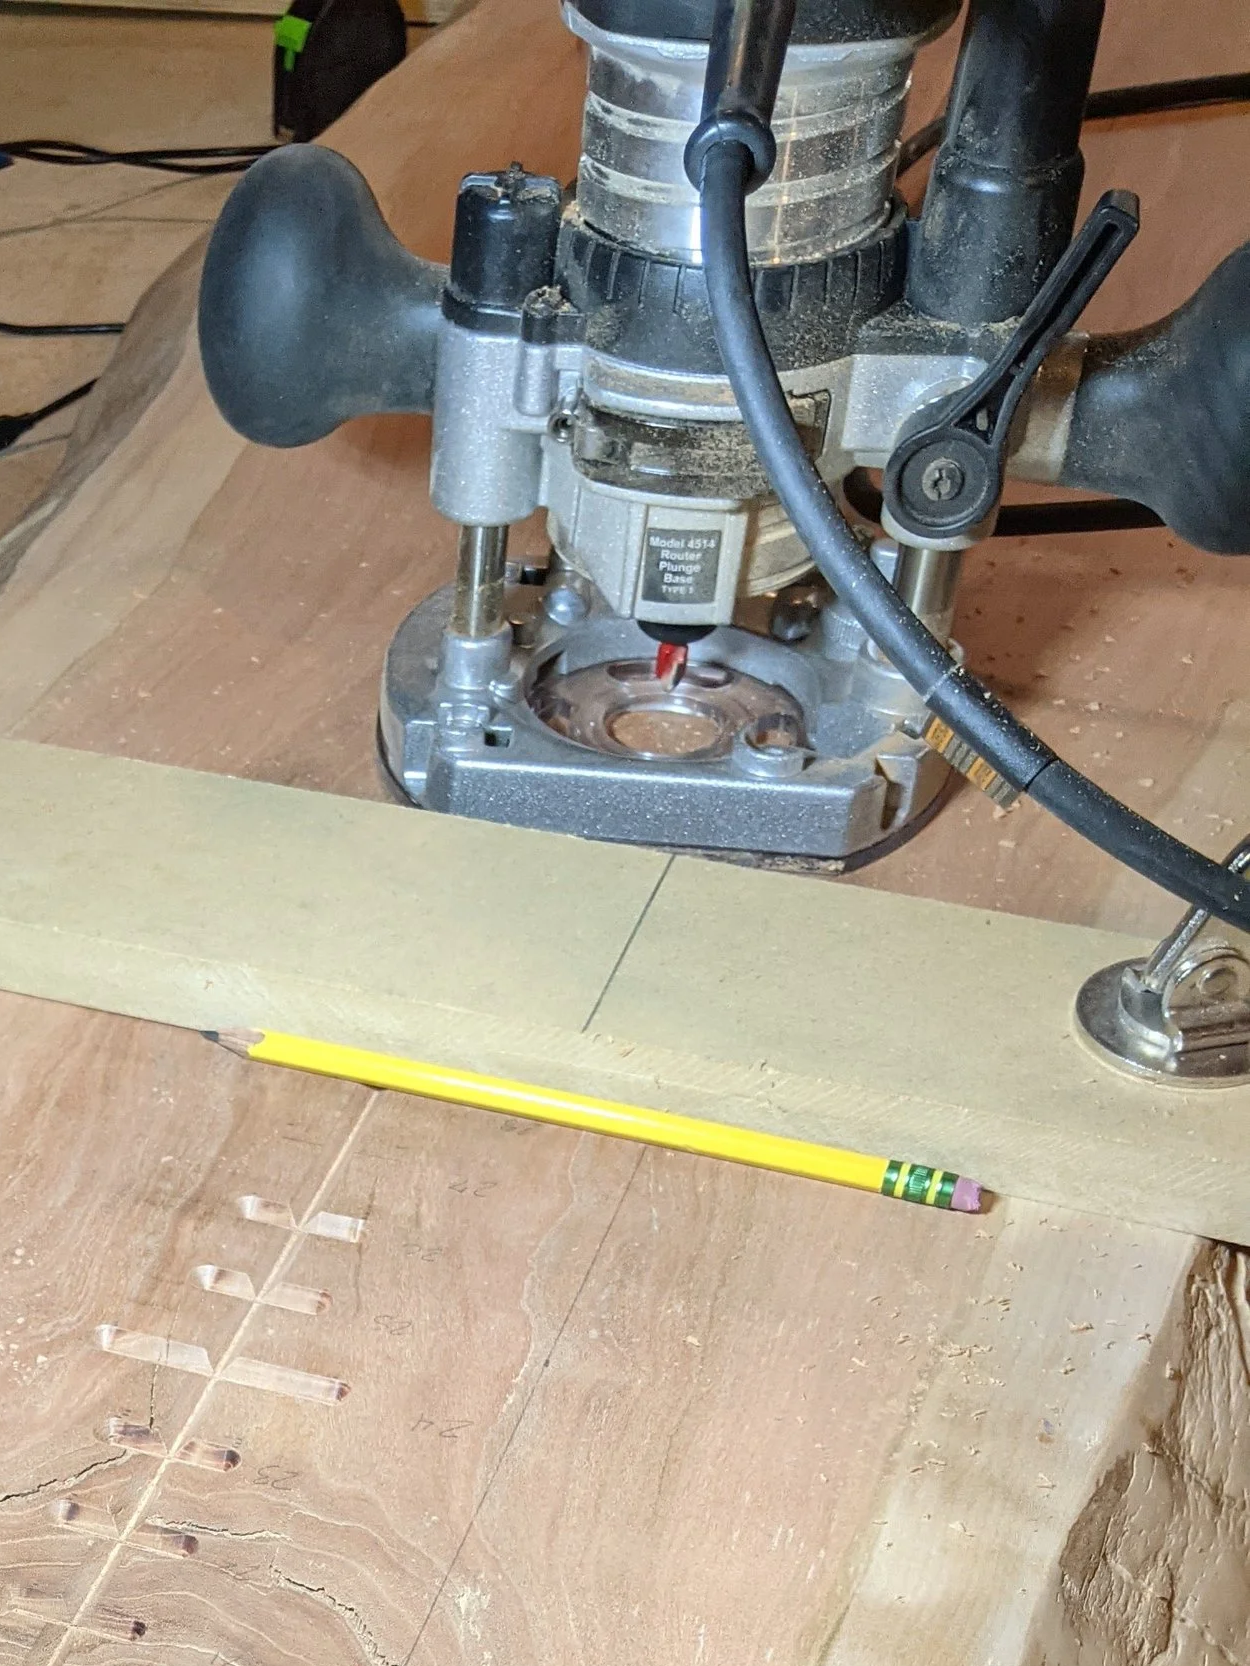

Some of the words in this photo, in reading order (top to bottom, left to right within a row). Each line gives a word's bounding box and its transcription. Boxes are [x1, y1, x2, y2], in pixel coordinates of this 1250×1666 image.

[649, 536, 685, 548] Model
[687, 537, 716, 549] 4514
[660, 549, 702, 560] Router
[658, 560, 702, 575] Plunge
[663, 572, 694, 583] Base
